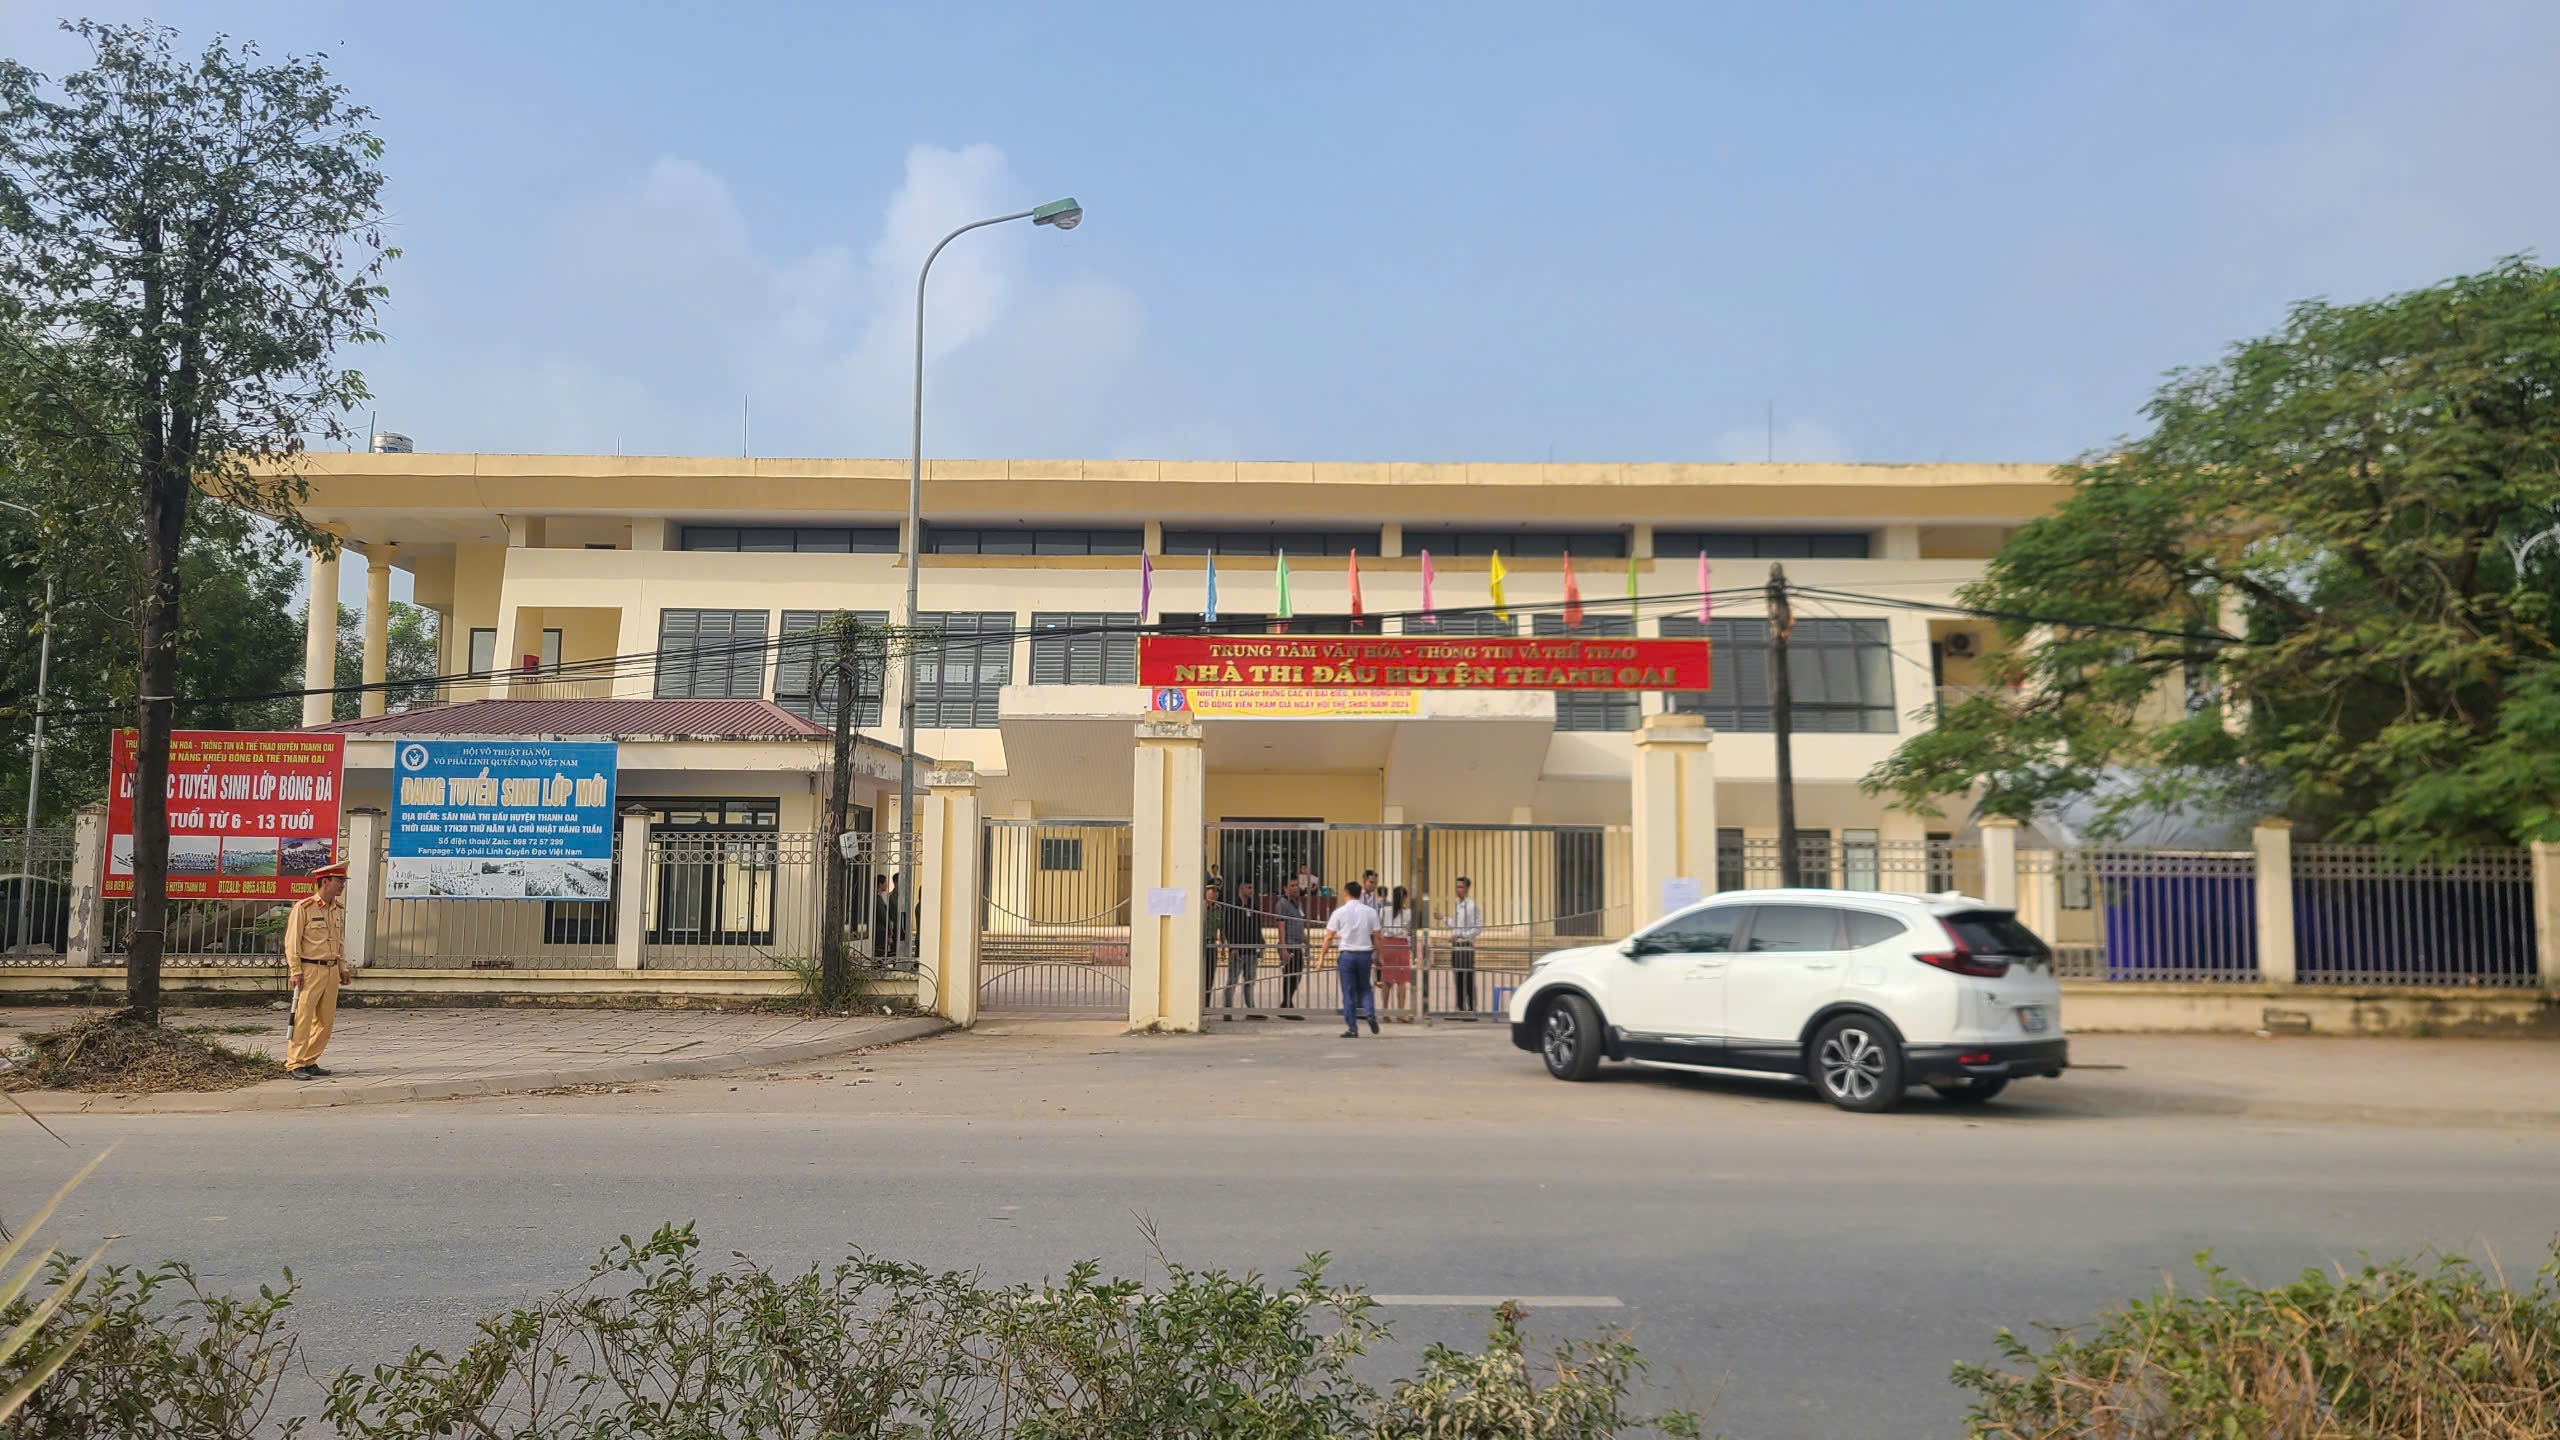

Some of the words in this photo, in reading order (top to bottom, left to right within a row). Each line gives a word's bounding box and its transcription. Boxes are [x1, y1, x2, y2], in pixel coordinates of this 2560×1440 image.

[1209, 644, 1273, 658] TRUNG
[1276, 642, 1317, 658] TÂM
[1322, 642, 1359, 658] VĂN
[1364, 643, 1403, 659] HÓA
[1416, 642, 1477, 659] THÔNG
[1481, 646, 1514, 659] TIN
[1518, 642, 1542, 660] VÀ
[1542, 641, 1581, 660] THỂ
[1585, 646, 1639, 660] THAO
[1175, 660, 1243, 683] NHÀ
[1248, 665, 1304, 683] THI
[1312, 658, 1378, 683] ĐẤU
[1385, 662, 1497, 688] HUYỆN
[1502, 666, 1613, 685] THANH
[1618, 667, 1677, 686] OAI
[1197, 689, 1219, 698] NHIỆT
[1221, 689, 1237, 698] LIỆT
[1235, 699, 1252, 708] VIÊN
[1255, 700, 1276, 708] THAM
[1279, 700, 1291, 708] GIA
[201, 740, 222, 750] THÔNG
[223, 741, 234, 750] TIN
[235, 740, 244, 751] VÀ
[260, 742, 276, 751] THAO
[277, 741, 299, 753] HUYỆN
[300, 743, 322, 752] THANH
[323, 743, 334, 752] OAI
[463, 746, 478, 757] HỘI
[481, 746, 492, 756] VÕ
[493, 747, 521, 757] THUẬT
[522, 746, 534, 756] HÀ
[535, 746, 551, 757] NỘI
[178, 751, 201, 762] NĂNG
[203, 751, 227, 762] KHIẾU
[229, 752, 251, 763] BÓNG
[253, 753, 264, 763] ĐÁ
[266, 752, 281, 764] TRẺ
[283, 754, 309, 764] THANH
[311, 754, 325, 764] OAI
[433, 757, 446, 765] VÕ
[447, 757, 468, 766] PHÁI
[469, 758, 489, 766] LINH
[520, 758, 538, 768] ĐẠO
[539, 757, 559, 768] VIỆT
[560, 759, 578, 767] NAM
[179, 764, 218, 800] TUYỂN
[219, 774, 250, 800] SINH
[252, 770, 276, 800] LỚP
[279, 770, 313, 801] BÓNG
[315, 770, 333, 801] ĐÁ
[401, 777, 446, 806] ĐANG
[448, 766, 499, 806] TUYỂN
[501, 778, 540, 807] SINH
[542, 772, 573, 807] LỚP
[575, 772, 608, 807] MỚI
[169, 806, 204, 829] TUỔI
[208, 810, 230, 829] TỪ
[231, 813, 241, 829] 6
[257, 814, 276, 830] 13
[280, 808, 315, 830] TUỔI
[401, 812, 415, 822] ĐỊA
[417, 810, 440, 821] ĐIỂM:
[441, 811, 458, 821] SÂN
[460, 811, 476, 821] NHÀ
[478, 812, 491, 821] THI
[492, 810, 508, 821] ĐẤU
[509, 812, 536, 823] HUYỆN
[537, 813, 563, 822] THANH
[564, 813, 578, 822] OAI
[400, 822, 419, 832] THỜI
[420, 824, 442, 832] GIAN:
[444, 824, 468, 833] 17H30
[470, 823, 486, 833] THỨ
[486, 823, 505, 833] NĂM
[506, 823, 517, 833] VÀ
[518, 823, 534, 833] CHỦ
[536, 823, 557, 835] NHẬT
[558, 823, 580, 834] HÀNG
[438, 836, 450, 845] Số
[450, 837, 467, 846] điện
[492, 838, 512, 846] Zalo:
[513, 838, 527, 846] 098
[528, 838, 538, 846] 72
[539, 838, 548, 846] 57
[418, 847, 453, 856] Fanpage:
[455, 847, 466, 855] Võ
[467, 847, 485, 856] phái
[486, 847, 504, 855] Linh
[531, 848, 548, 856] Đạo
[548, 847, 563, 856] Việt
[565, 848, 583, 856] Nam
